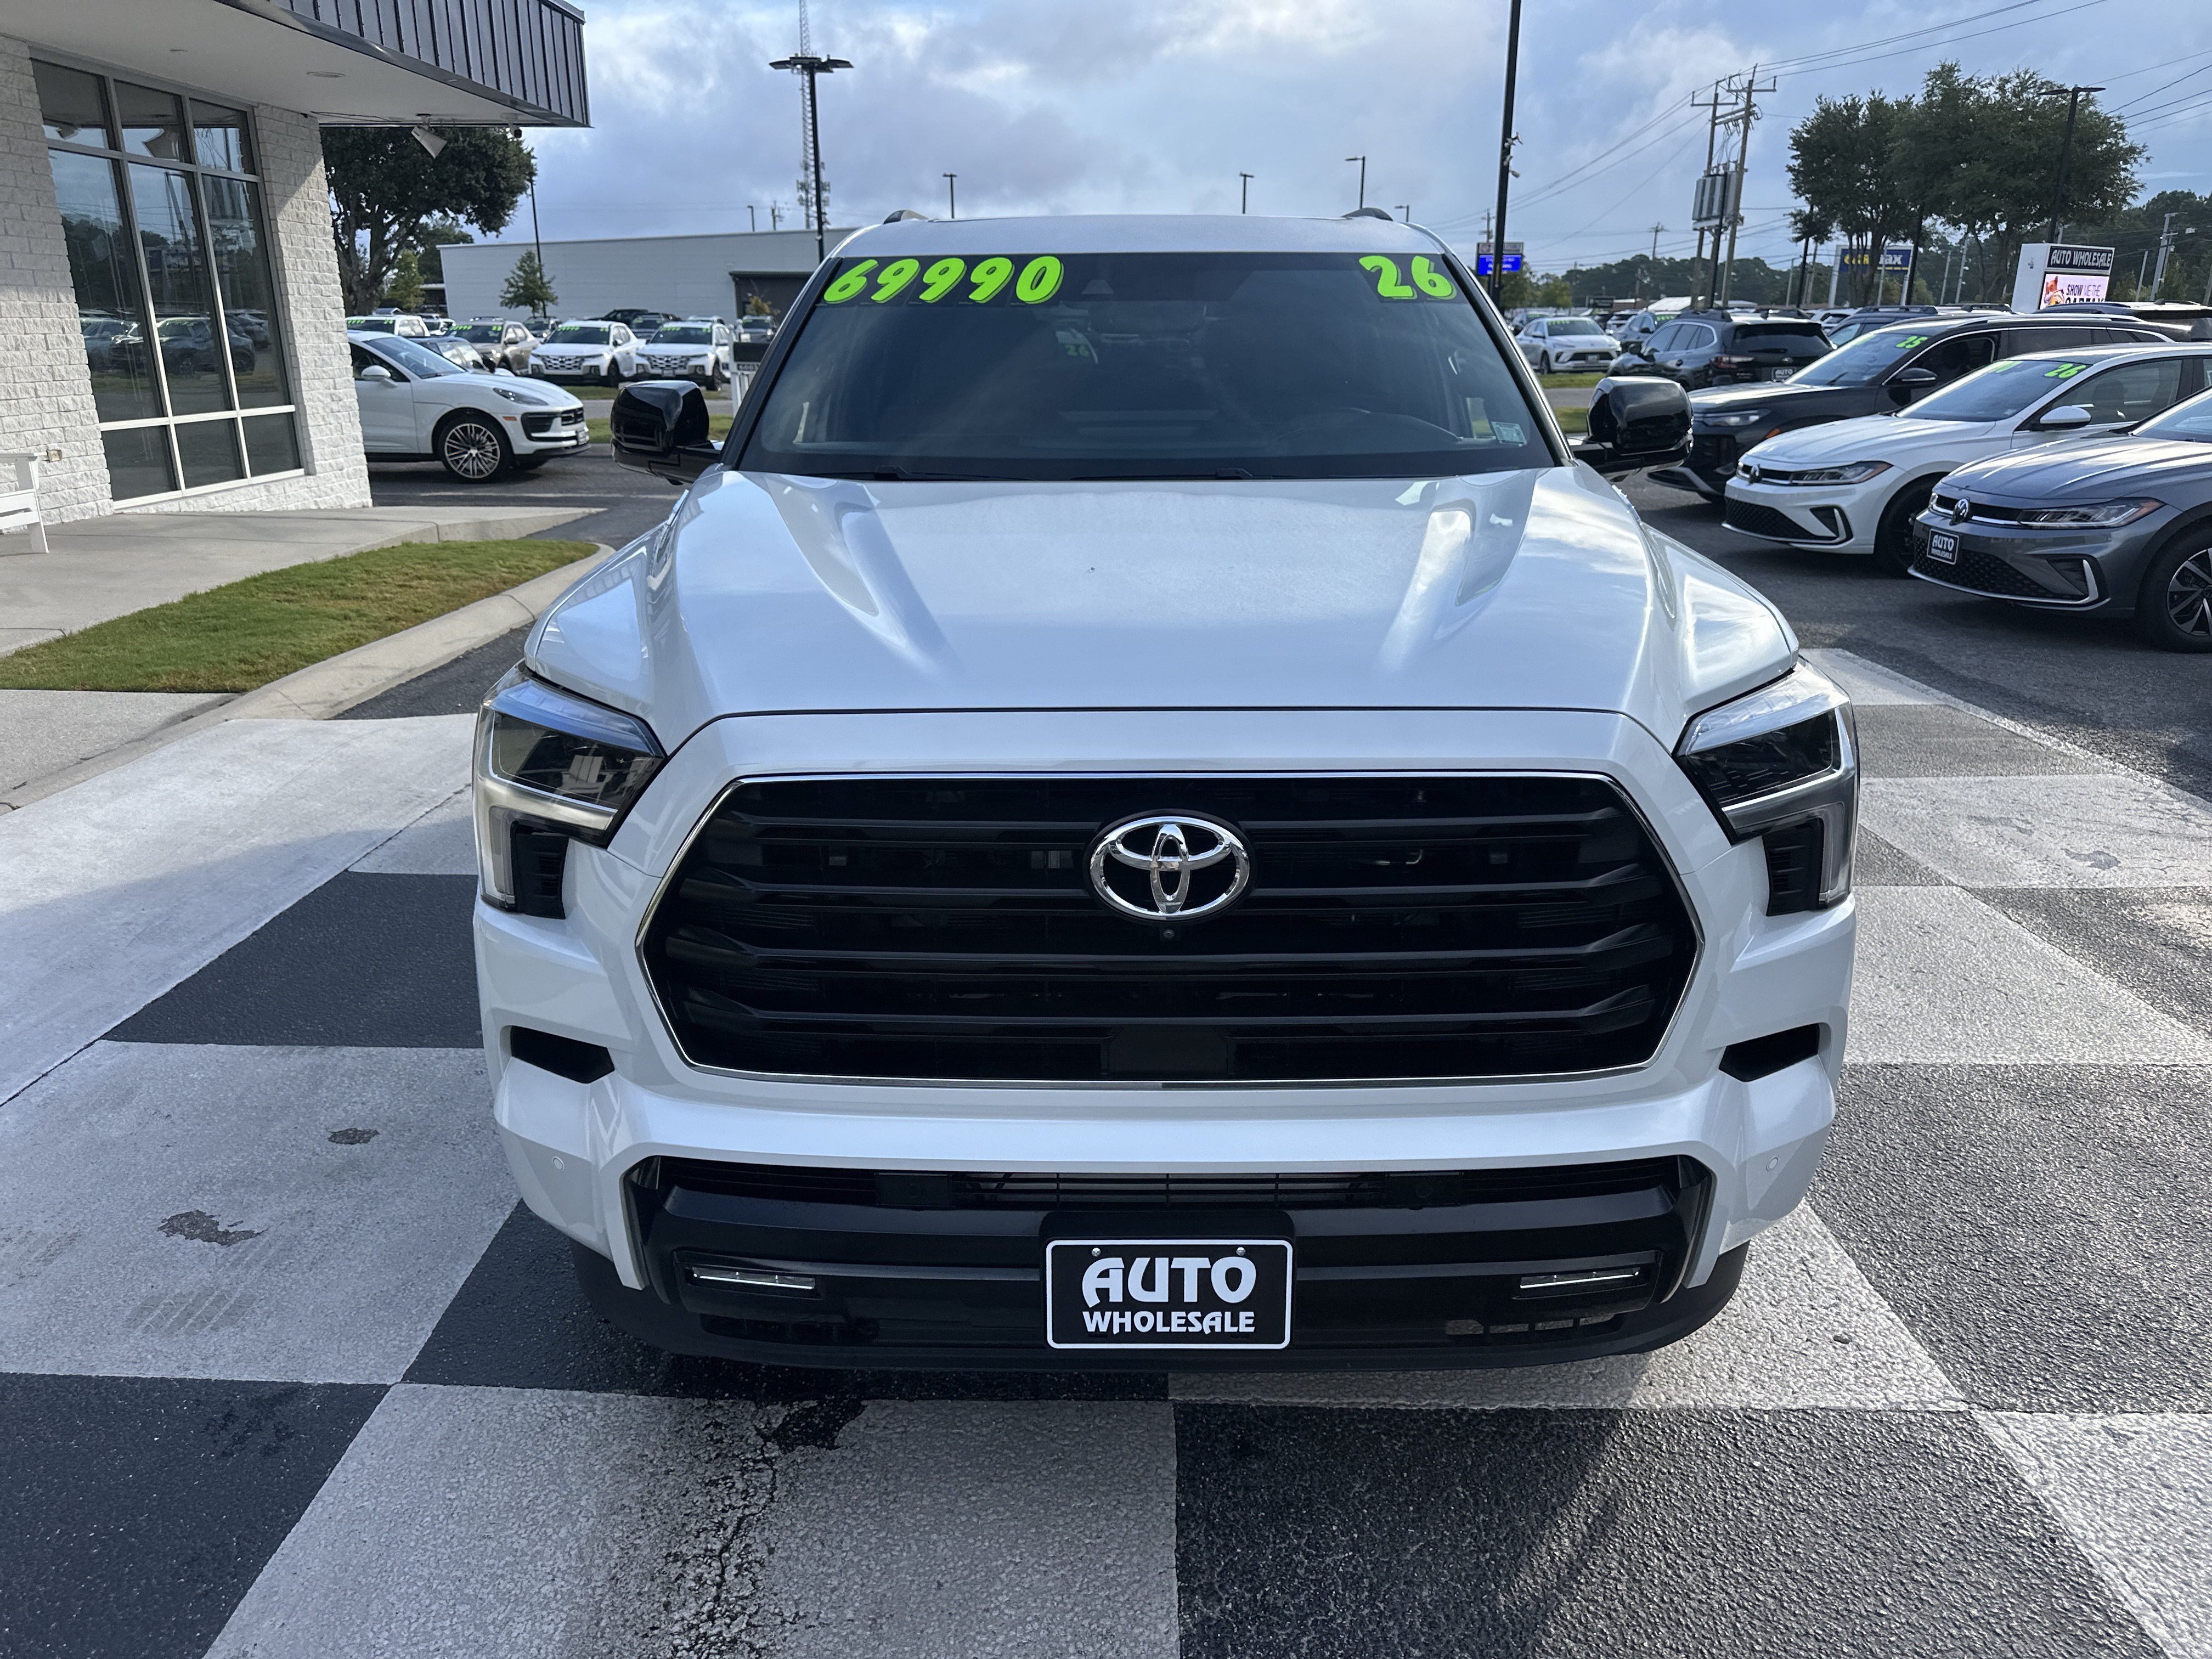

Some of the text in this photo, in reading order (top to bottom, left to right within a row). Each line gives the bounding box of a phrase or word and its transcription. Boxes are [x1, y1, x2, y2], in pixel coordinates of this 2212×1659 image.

[2051, 250, 2112, 267] AUTO WHOLESALE
[823, 256, 1064, 304] 69990
[1358, 255, 1457, 300] 26
[2067, 284, 2084, 296] SHOW
[1895, 335, 1928, 349] 25
[2043, 363, 2086, 379] 26
[1932, 534, 1954, 551] AUTO
[1082, 1256, 1256, 1308] AUTO
[1082, 1311, 1256, 1335] WHOLESALE
